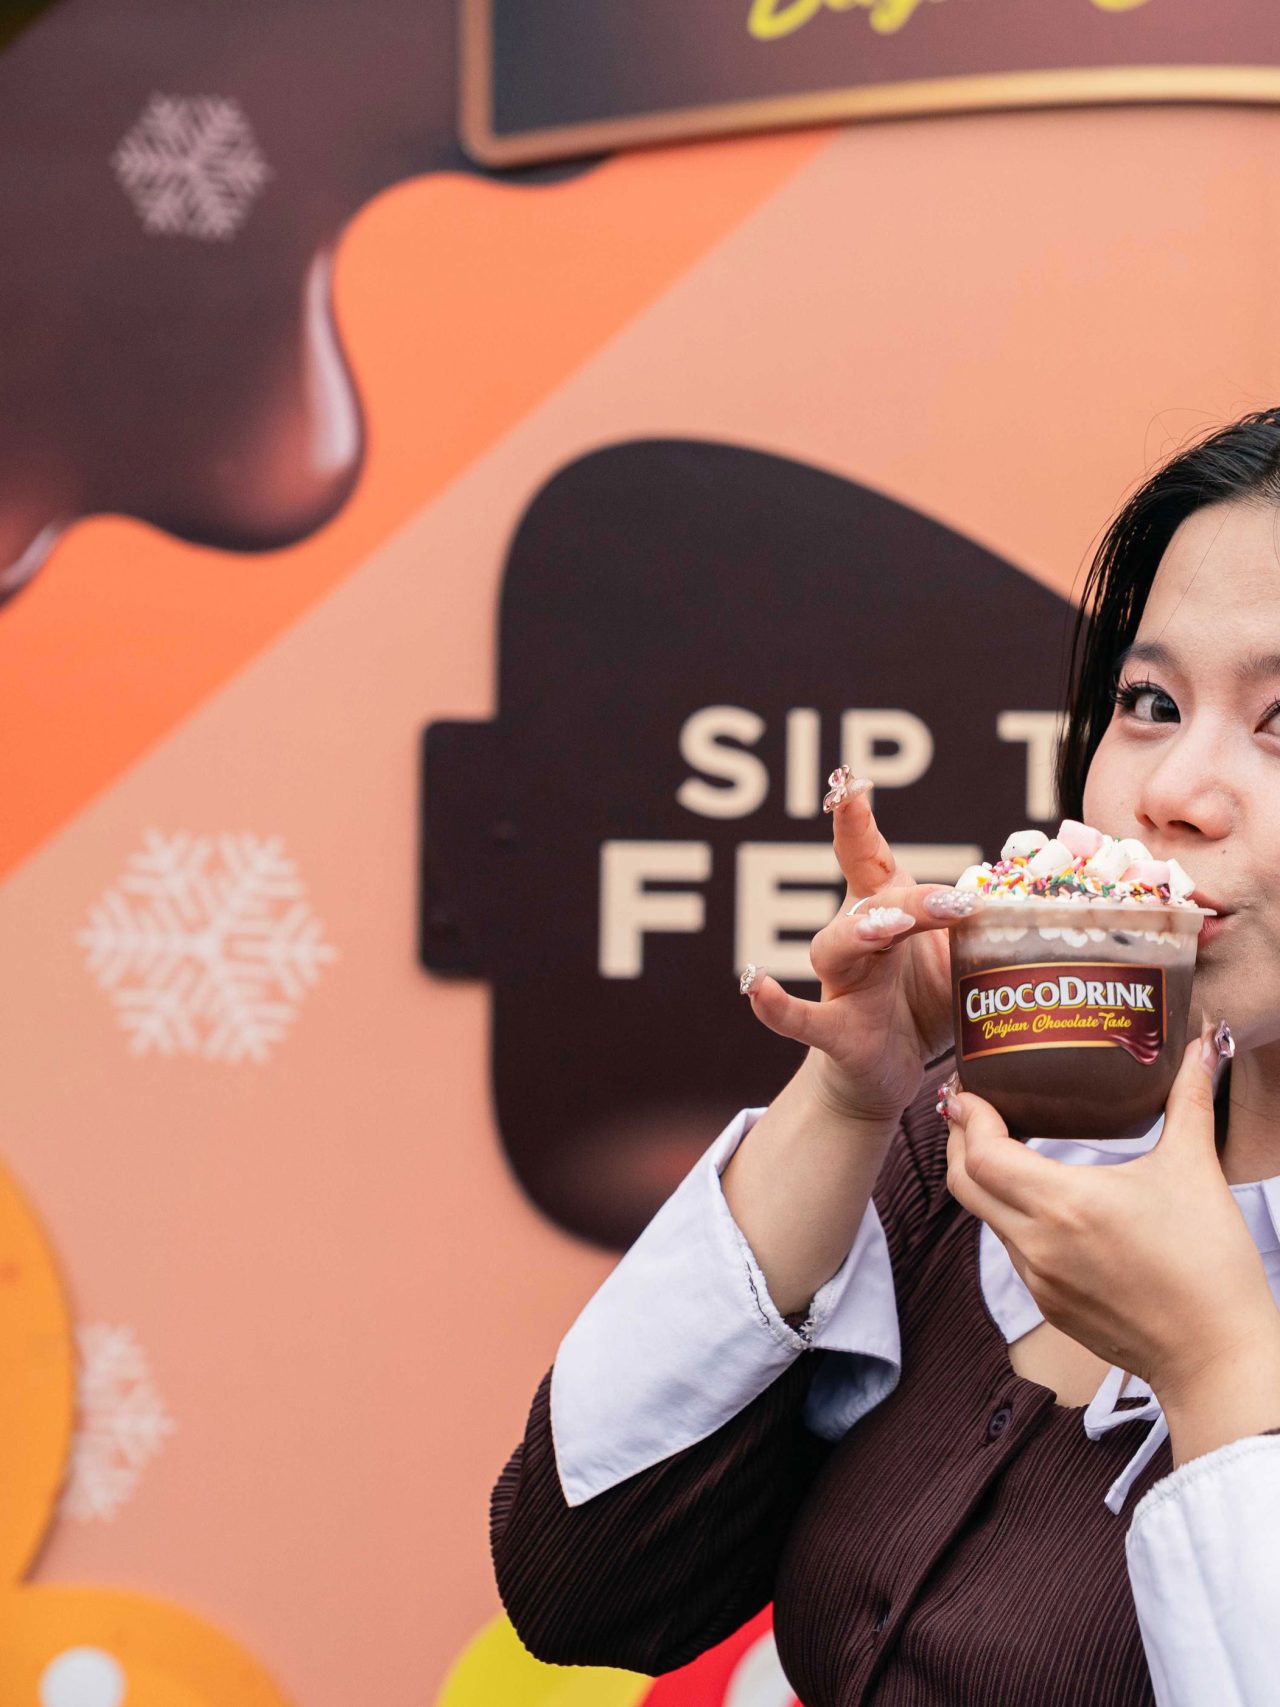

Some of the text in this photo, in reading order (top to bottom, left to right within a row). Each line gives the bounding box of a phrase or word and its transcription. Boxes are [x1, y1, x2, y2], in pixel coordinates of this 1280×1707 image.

[676, 704, 935, 819] SIP
[982, 1011, 1132, 1040] Belgian Chocolate Taste
